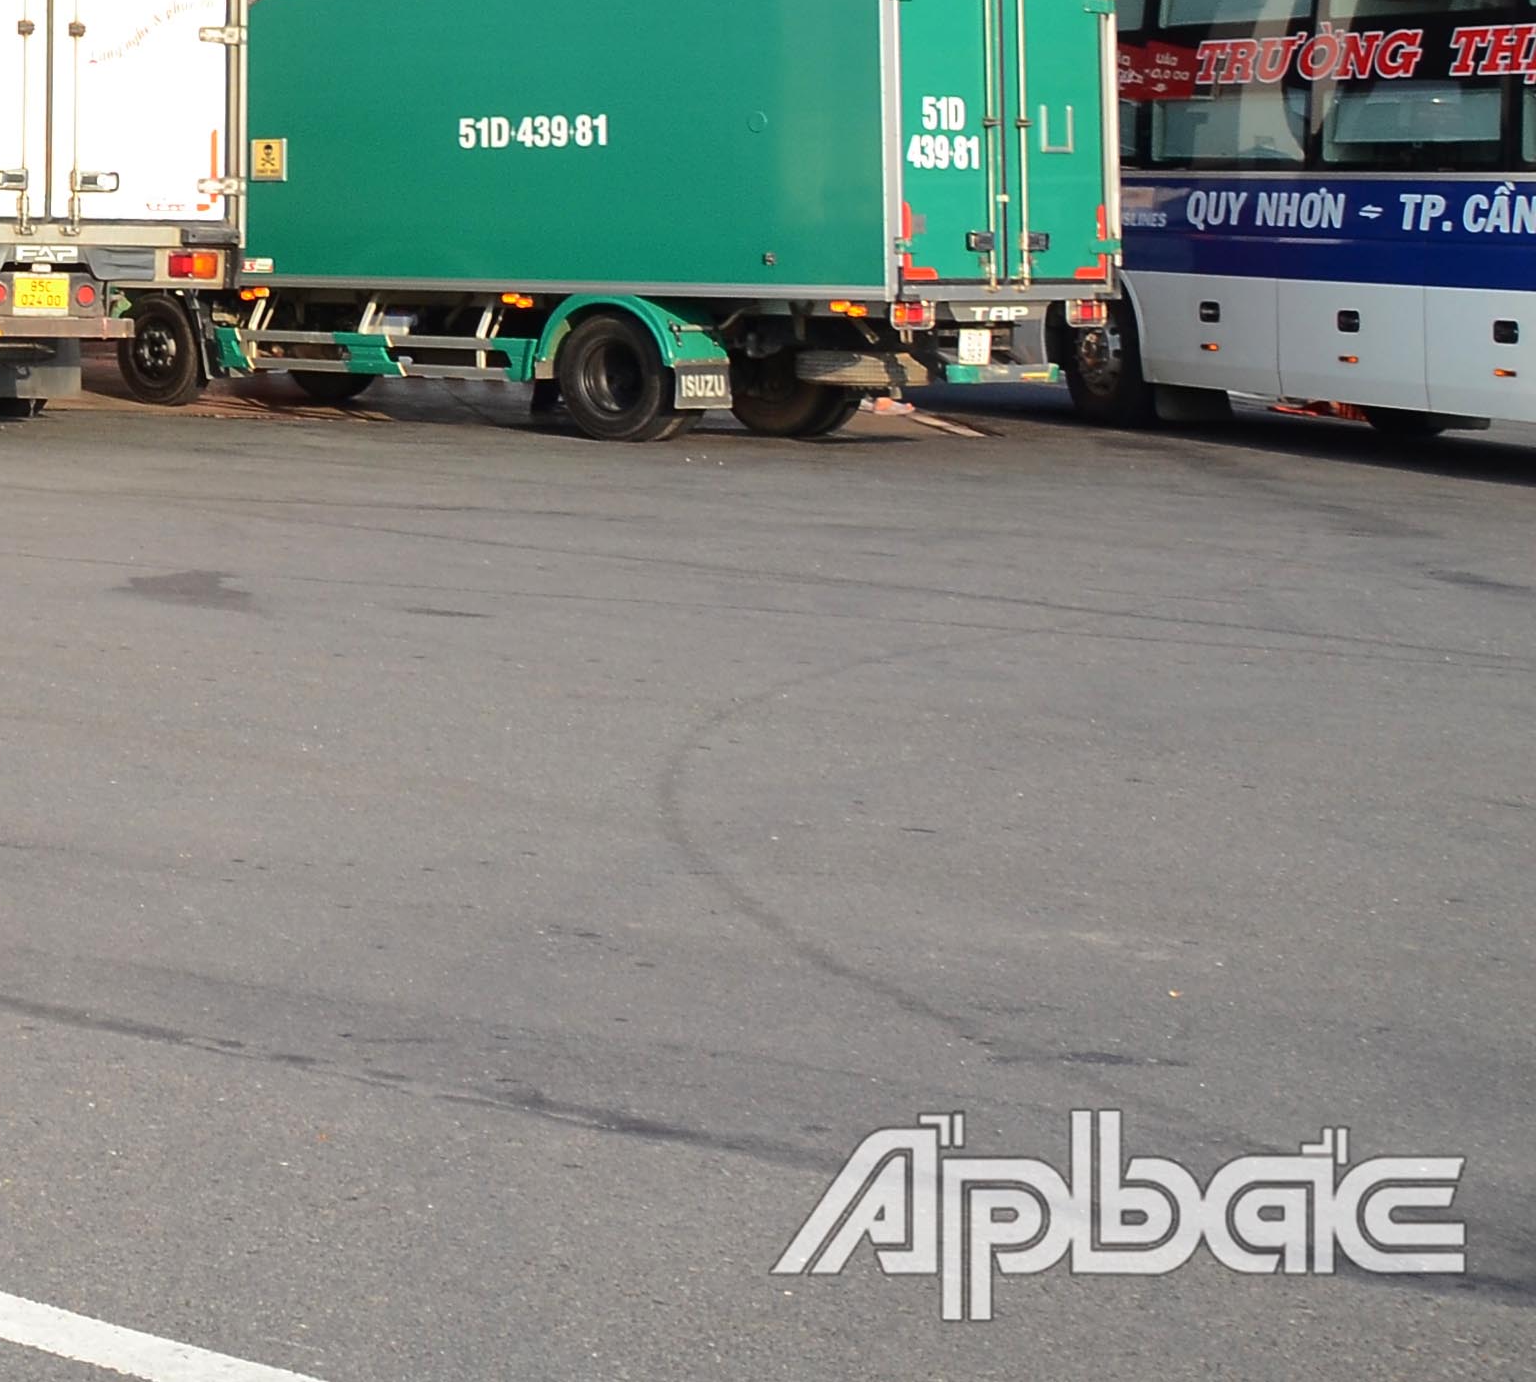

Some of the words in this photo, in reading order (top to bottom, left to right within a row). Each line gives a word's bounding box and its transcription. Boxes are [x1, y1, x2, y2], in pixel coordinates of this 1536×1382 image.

[1195, 21, 1424, 85] TRƯỜNG
[922, 96, 965, 131] 51D
[1122, 212, 1168, 227] SLINES
[1186, 190, 1248, 231] QUY
[1255, 187, 1346, 229] NHƠN
[1399, 193, 1453, 233] TP.
[1462, 181, 1536, 234] CẦN
[31, 280, 53, 293] 85C
[969, 305, 1029, 322] TAP
[680, 373, 726, 399] ISUZU
